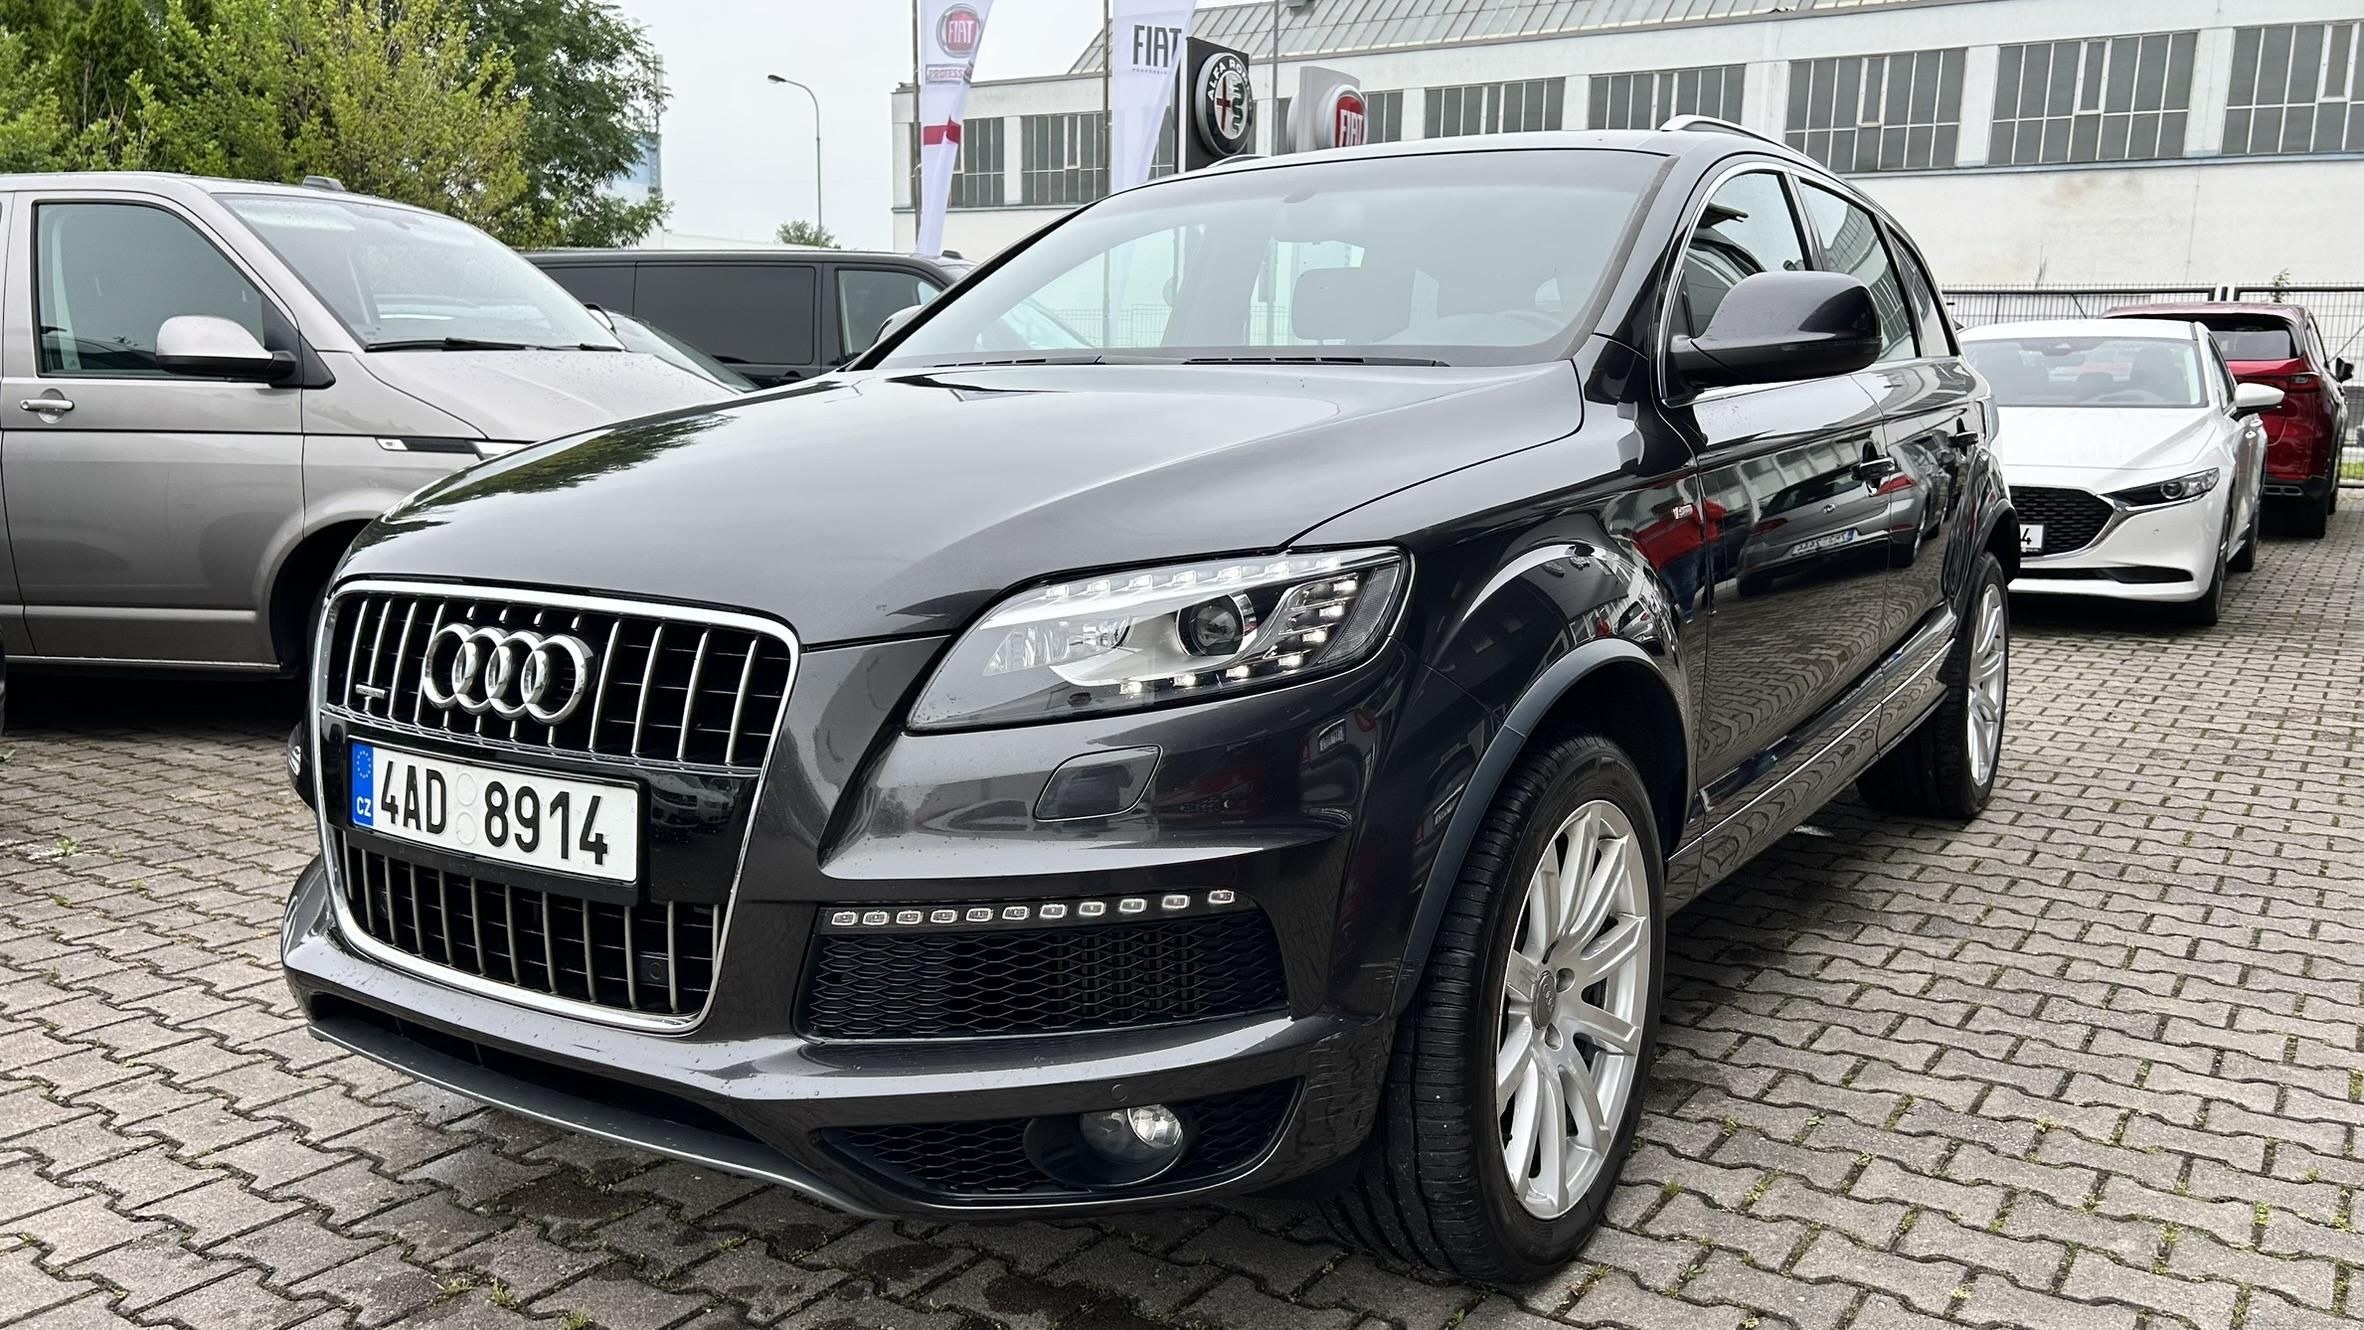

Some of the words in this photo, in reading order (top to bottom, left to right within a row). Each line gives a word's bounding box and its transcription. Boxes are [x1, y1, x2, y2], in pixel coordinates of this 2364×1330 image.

[948, 20, 975, 44] FIAT
[1133, 25, 1182, 67] FIAT
[1208, 62, 1226, 101] ALFA
[1339, 109, 1364, 147] FIAT
[356, 796, 372, 818] CZ
[380, 760, 447, 836] 4AD
[484, 780, 609, 866] 8914
